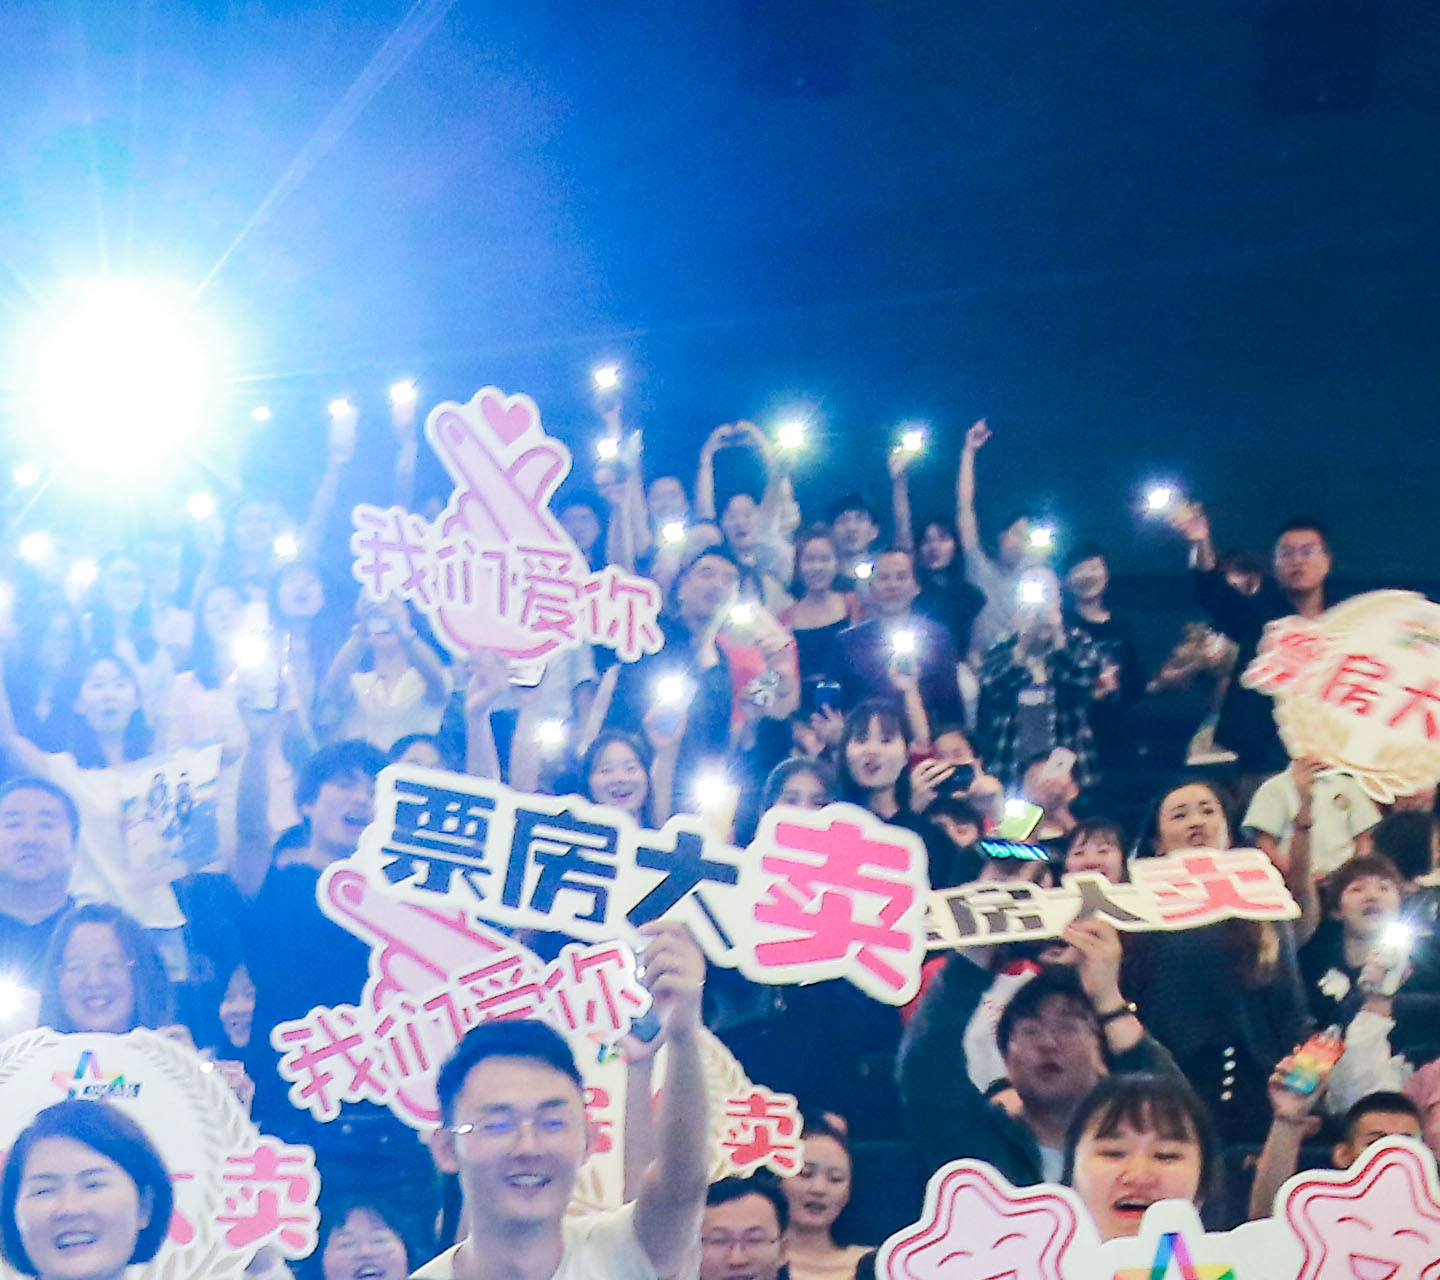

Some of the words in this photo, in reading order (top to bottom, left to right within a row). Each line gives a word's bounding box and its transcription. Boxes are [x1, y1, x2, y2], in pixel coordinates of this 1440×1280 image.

[359, 514, 657, 654] 我们爱你
[382, 779, 916, 992] 票房大卖
[926, 856, 1287, 943] 房大卖
